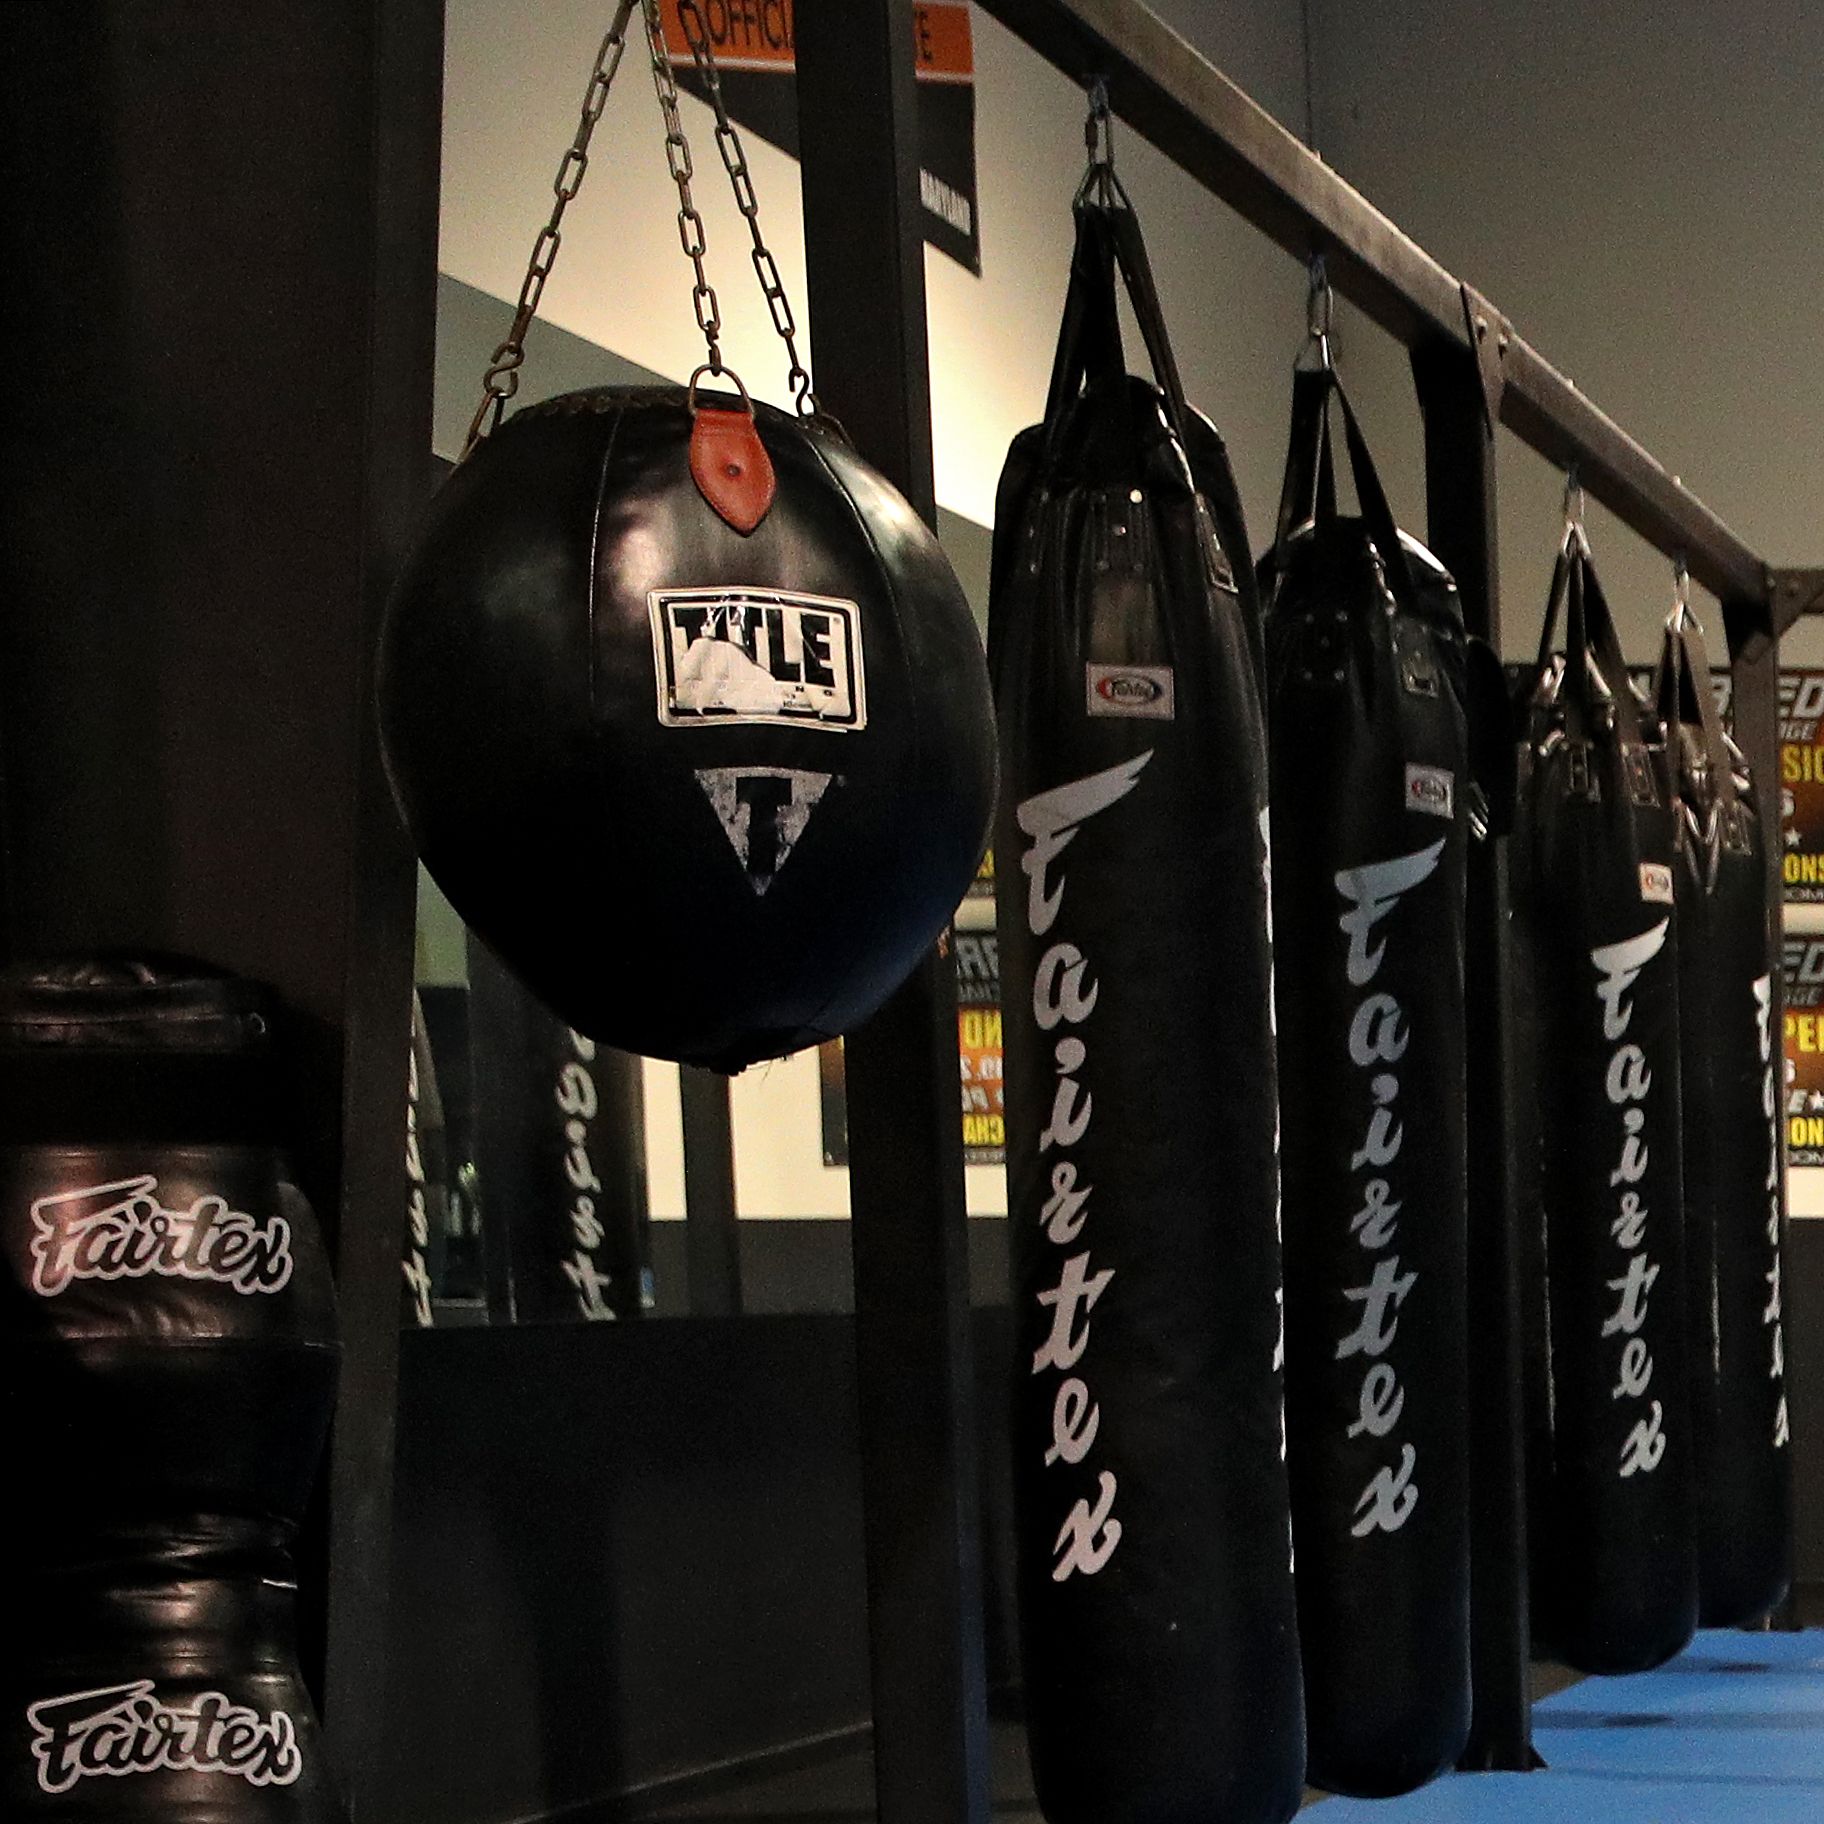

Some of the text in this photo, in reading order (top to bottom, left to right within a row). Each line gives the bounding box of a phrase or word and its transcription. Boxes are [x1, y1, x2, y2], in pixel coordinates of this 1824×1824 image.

[30, 1173, 294, 1296] Fairtex
[1017, 748, 1154, 1582] Fairtex
[1334, 836, 1446, 1538] Fairtex
[1591, 916, 1670, 1478] Fairtex
[27, 1679, 302, 1794] Fairtex
